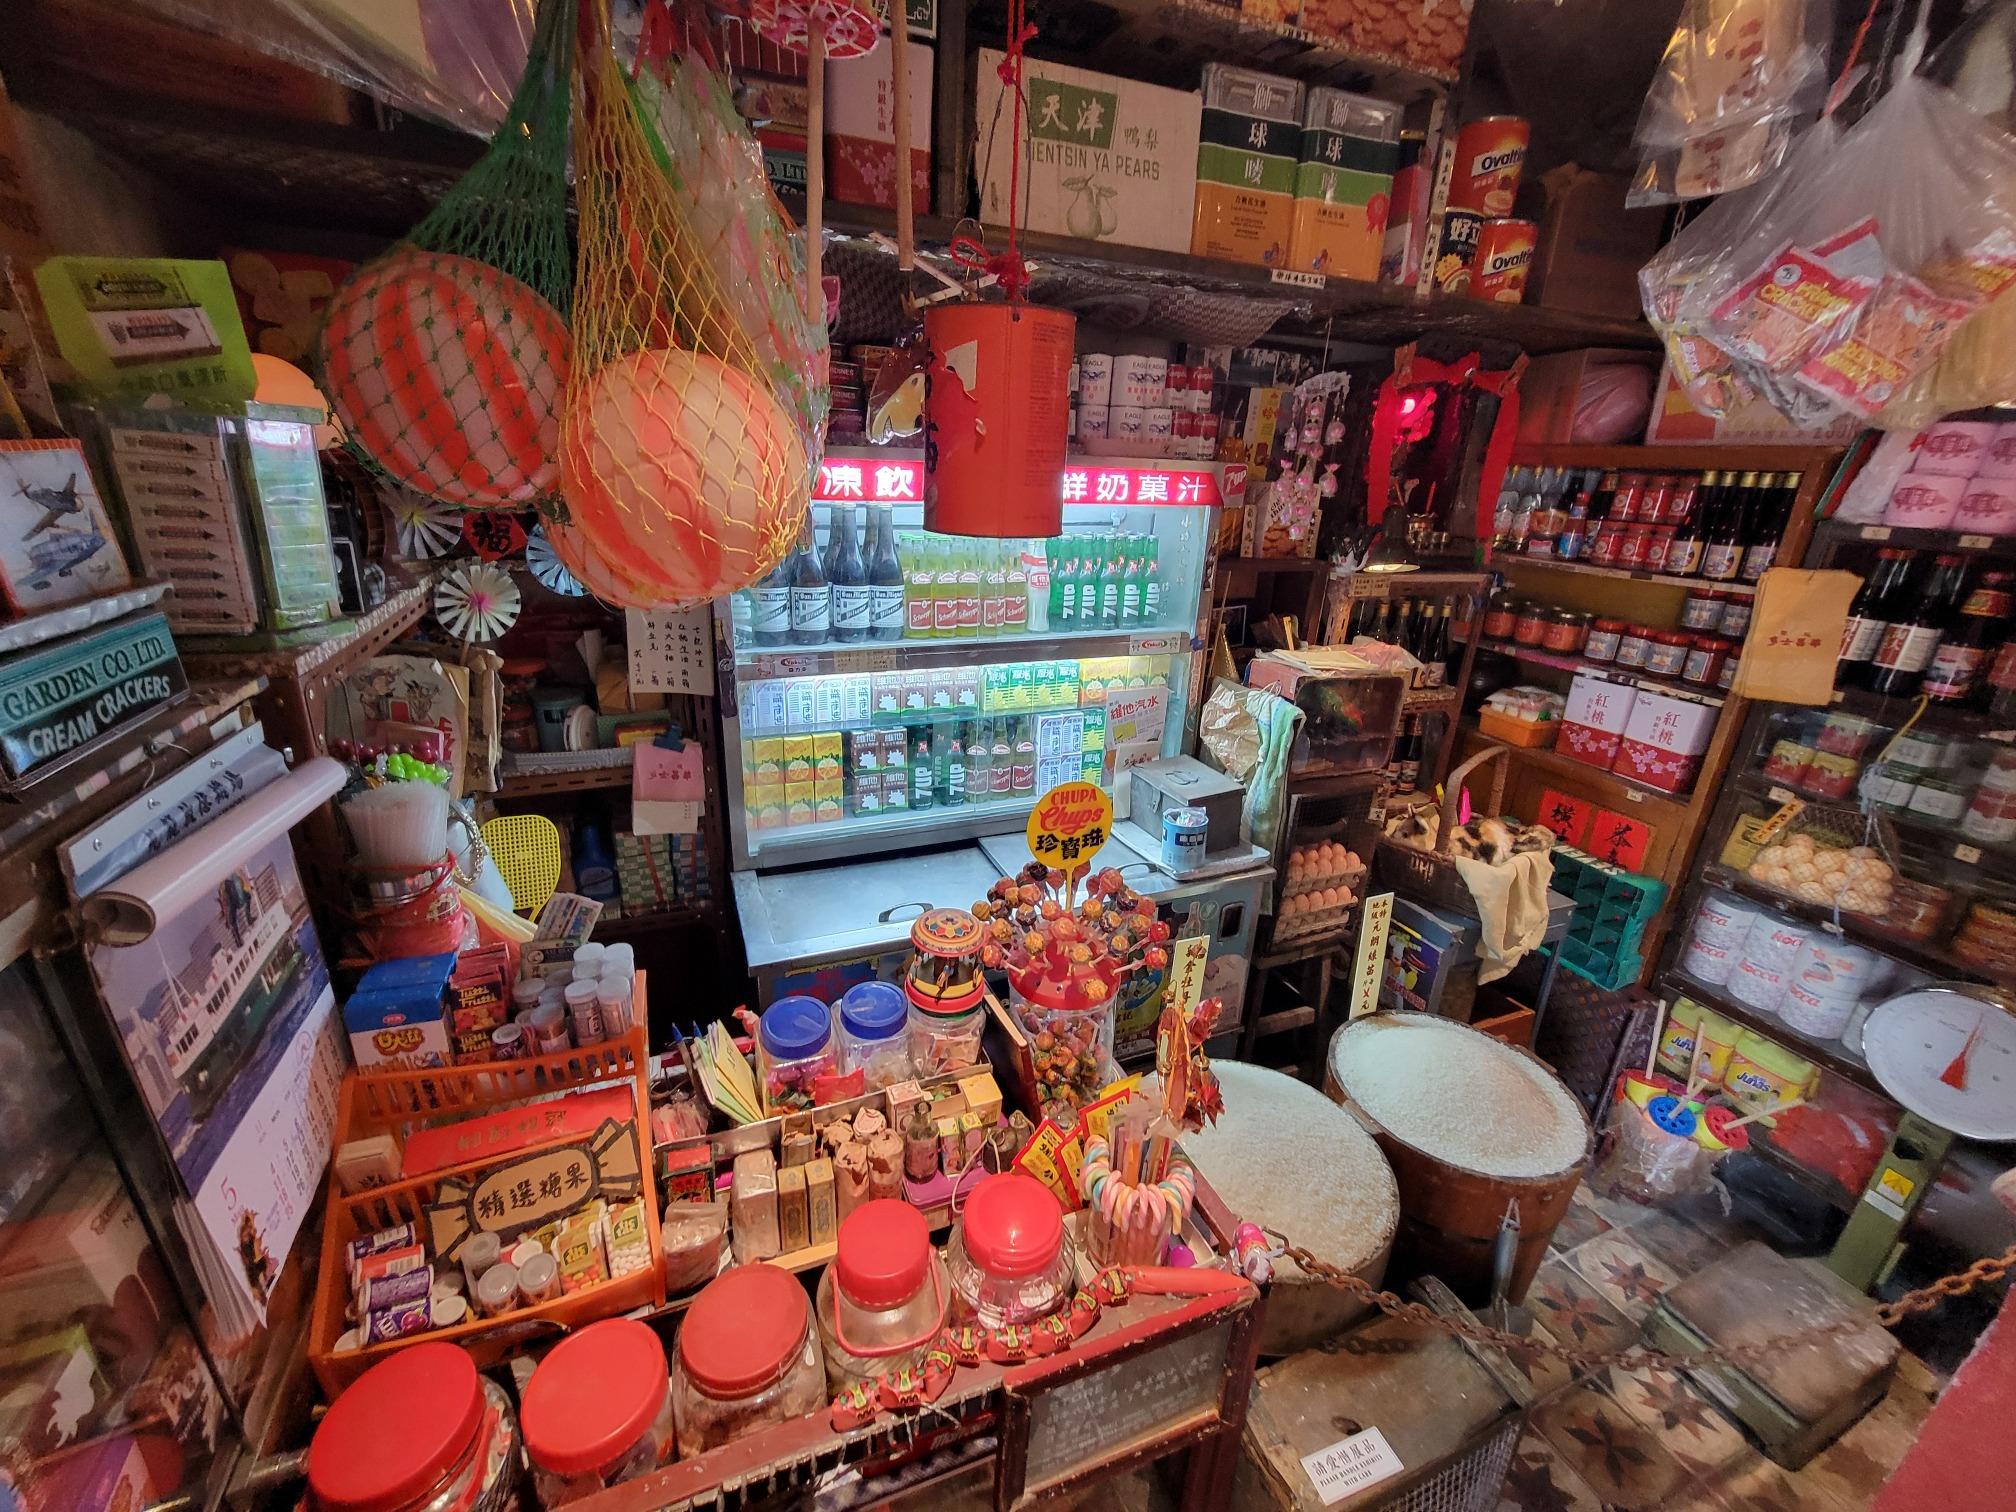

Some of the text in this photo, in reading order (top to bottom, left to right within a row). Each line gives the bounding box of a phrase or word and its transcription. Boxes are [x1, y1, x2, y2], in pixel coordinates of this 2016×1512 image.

[1038, 93, 1105, 142] 天津
[1124, 125, 1159, 151] 鴨梨
[1023, 139, 1161, 180] TIENTSIN YA PEARS
[4, 635, 165, 723] GARDEN CO. LTD.
[28, 674, 171, 758] CREAM CRACKERS
[1110, 695, 1159, 721] 維他汽水
[1591, 691, 1611, 727] 紅桃
[1658, 710, 1682, 748] 紅桃
[1050, 788, 1098, 807] CHUPA
[1039, 806, 1104, 836] Chups
[1035, 828, 1105, 861] 珍寶珠
[220, 1175, 238, 1211] 5
[478, 1161, 590, 1219] 精選糖果
